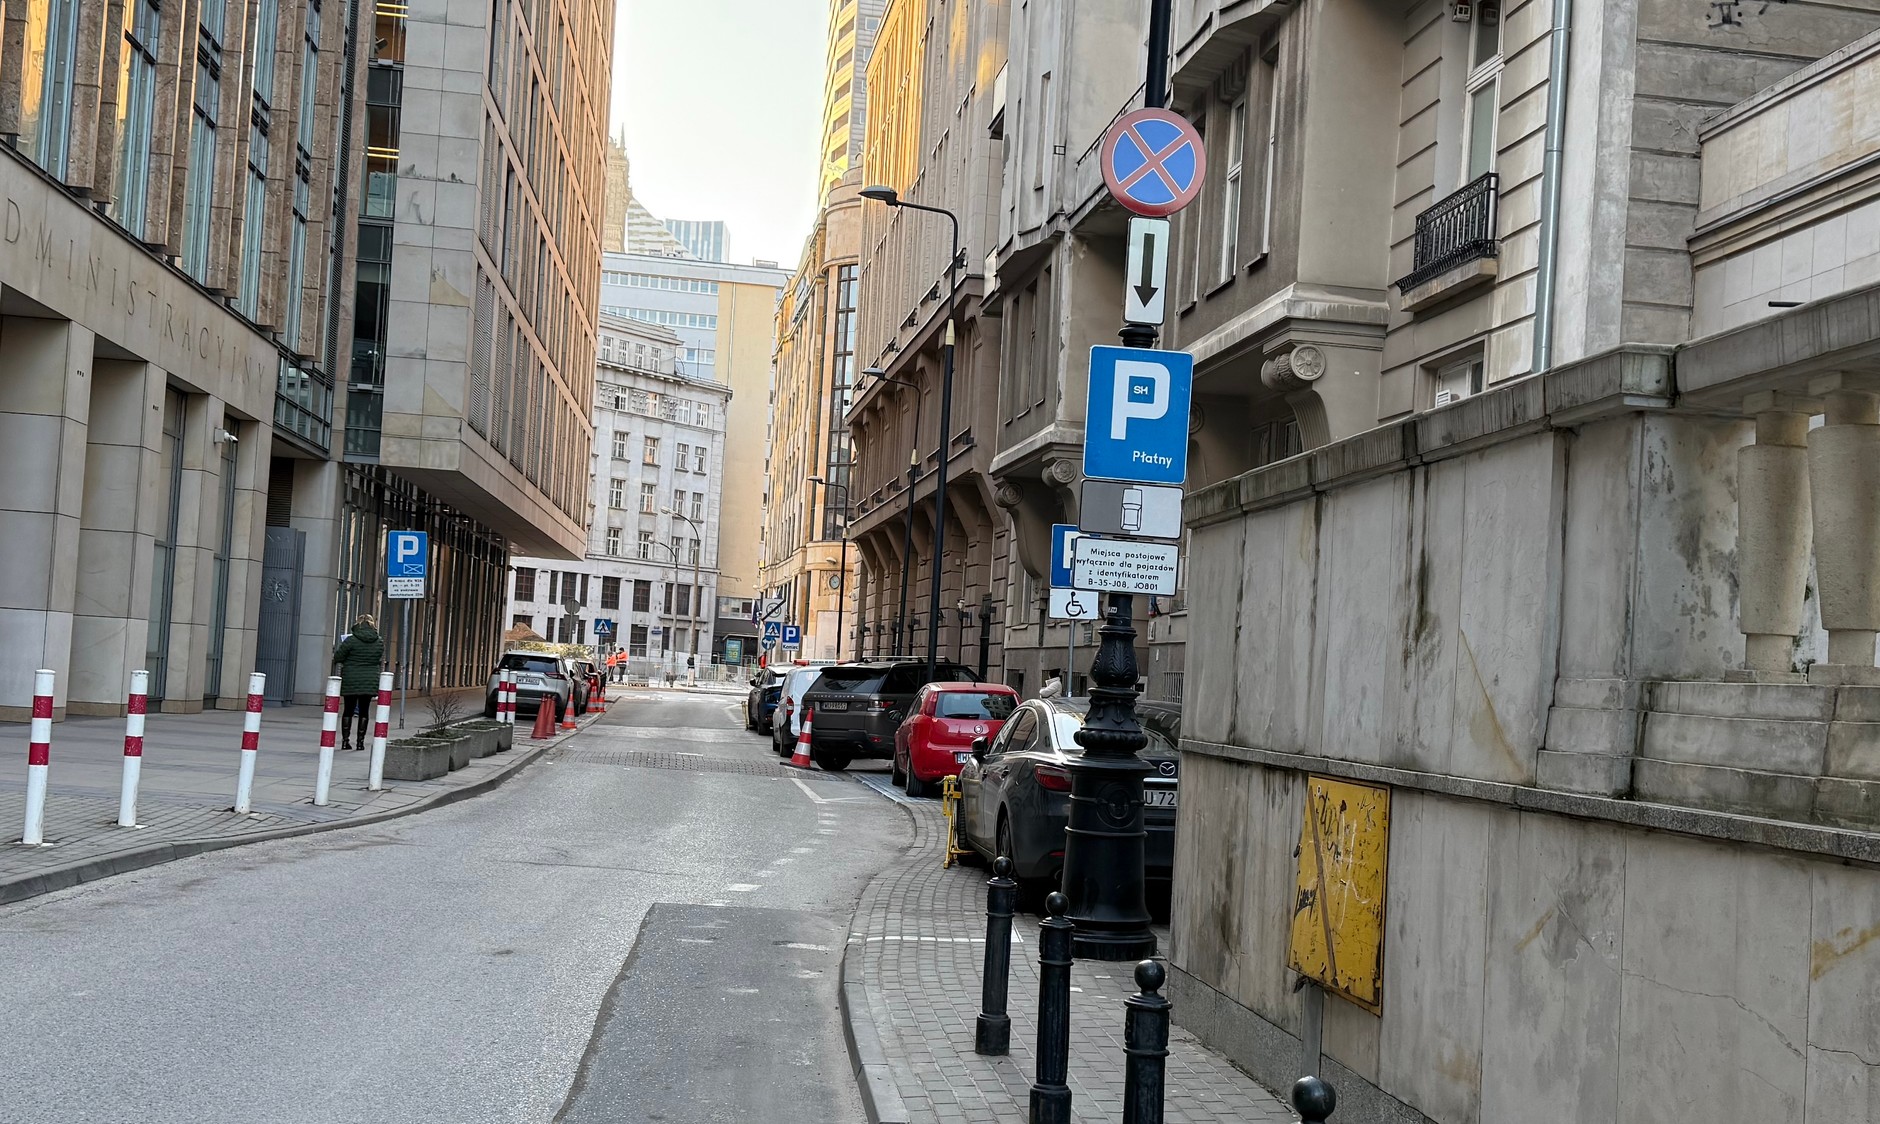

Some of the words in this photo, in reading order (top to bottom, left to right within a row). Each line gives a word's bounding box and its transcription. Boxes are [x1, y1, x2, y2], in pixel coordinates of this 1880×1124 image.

[1111, 360, 1171, 440] P
[1132, 450, 1173, 469] Płatny
[397, 535, 419, 563] P
[1090, 548, 1121, 557] Miejsca
[1125, 552, 1166, 561] postojowe
[1076, 558, 1115, 566] wyłącznie
[1136, 563, 1175, 572] pojazdów
[1097, 569, 1160, 580] identyfikatorem
[1088, 578, 1130, 589] B-35-J08,
[786, 627, 797, 641] P
[1158, 791, 1175, 806] 72
